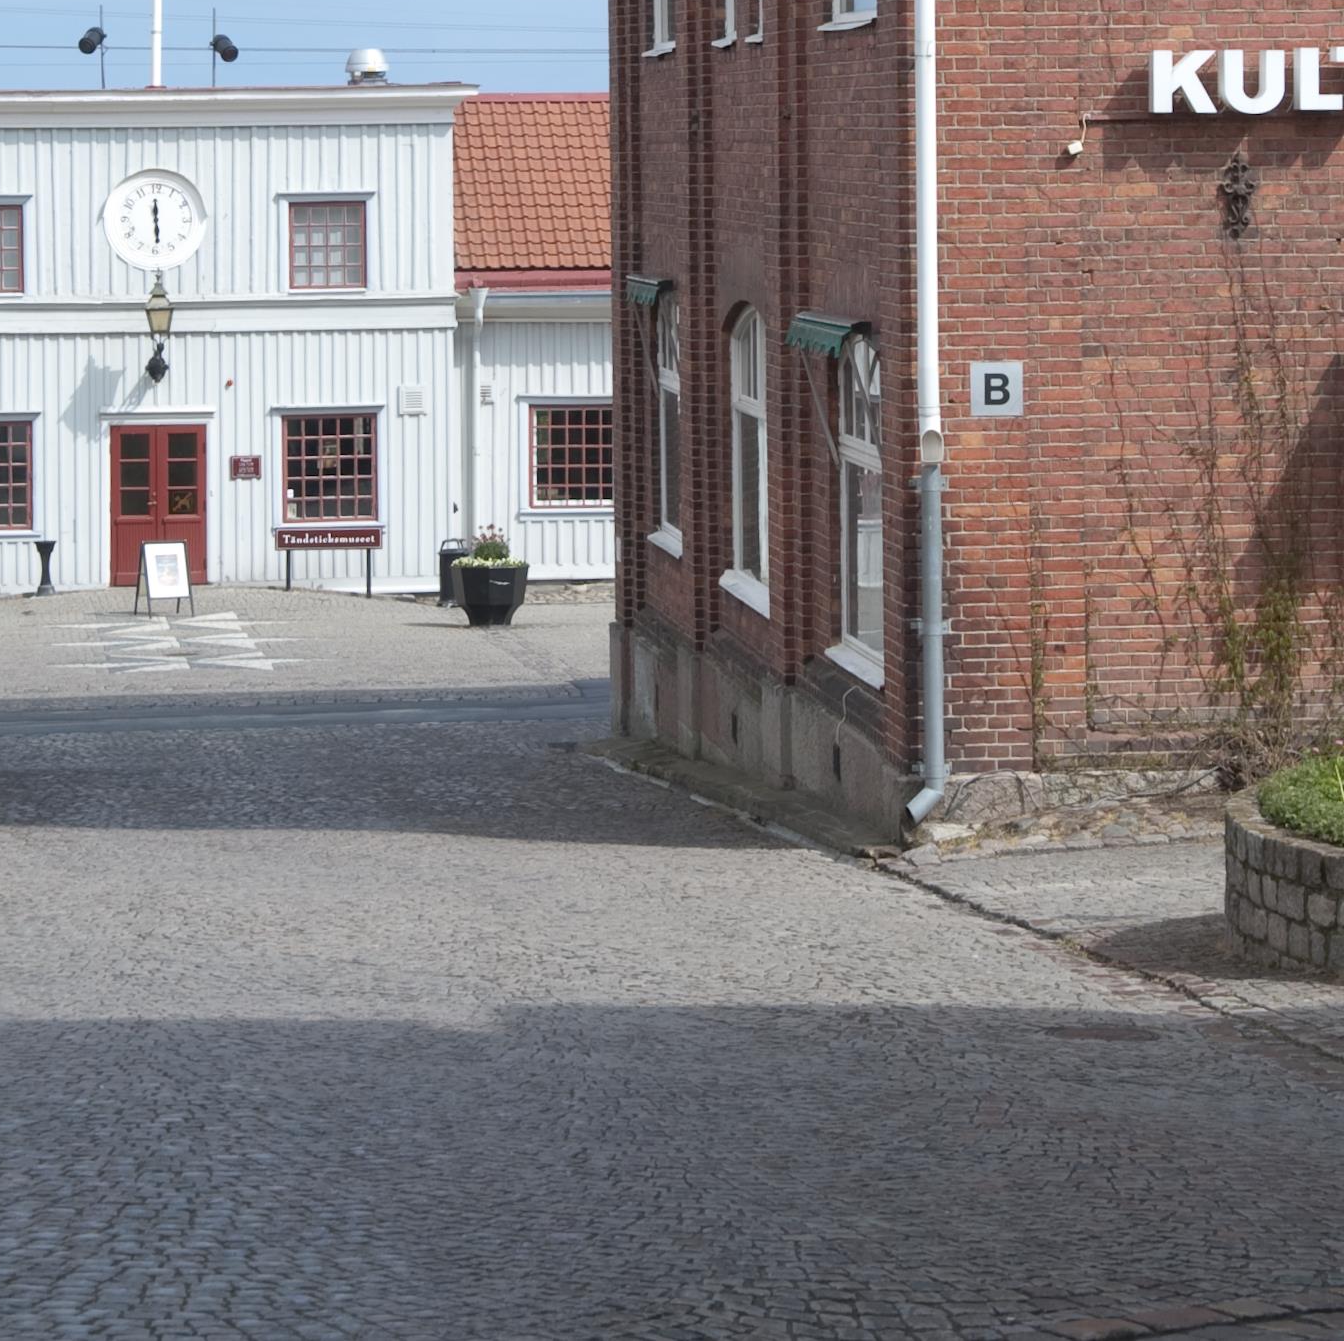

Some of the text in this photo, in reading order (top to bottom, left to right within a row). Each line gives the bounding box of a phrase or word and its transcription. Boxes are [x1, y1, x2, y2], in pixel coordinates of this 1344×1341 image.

[152, 183, 162, 194] 12
[983, 372, 1011, 406] B
[282, 532, 376, 545] Tändsticksmuseet
